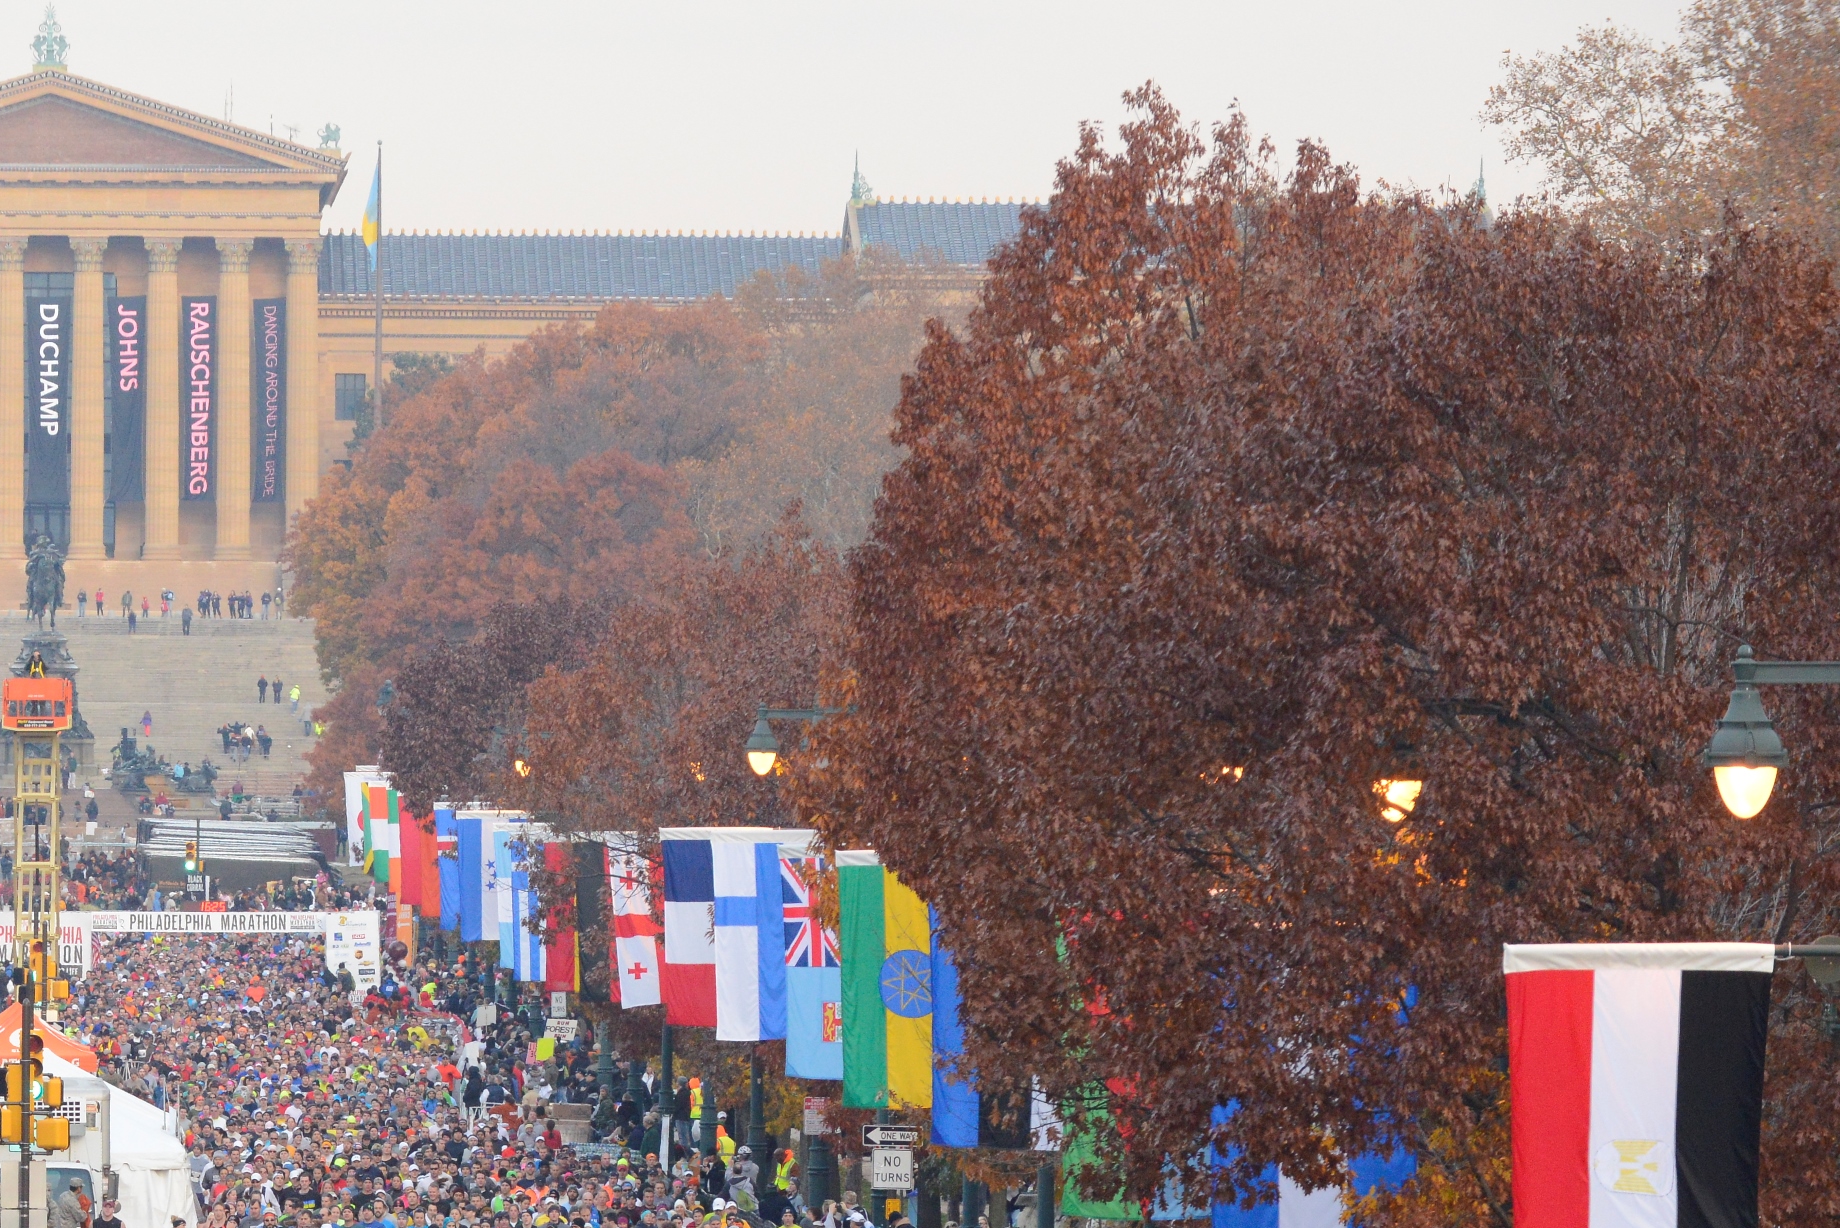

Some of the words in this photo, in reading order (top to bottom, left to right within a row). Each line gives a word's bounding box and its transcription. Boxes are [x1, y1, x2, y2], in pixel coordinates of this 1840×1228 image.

[117, 304, 138, 391] JOHNS
[264, 306, 278, 368] DANCING
[39, 304, 59, 435] DUCHAMP
[190, 302, 210, 495] RAUSCHENBERG
[266, 371, 278, 427] AROUND
[266, 430, 277, 455] THE
[263, 461, 275, 497] BRIDE
[188, 875, 202, 883] BLACK
[130, 914, 211, 930] PHILADELPHIA
[221, 914, 286, 930] MARATHON
[71, 1058, 80, 1067] G
[880, 1131, 896, 1140] ONE
[898, 1131, 917, 1140] WAY
[883, 1156, 901, 1167] NO
[875, 1172, 910, 1183] TURNS
